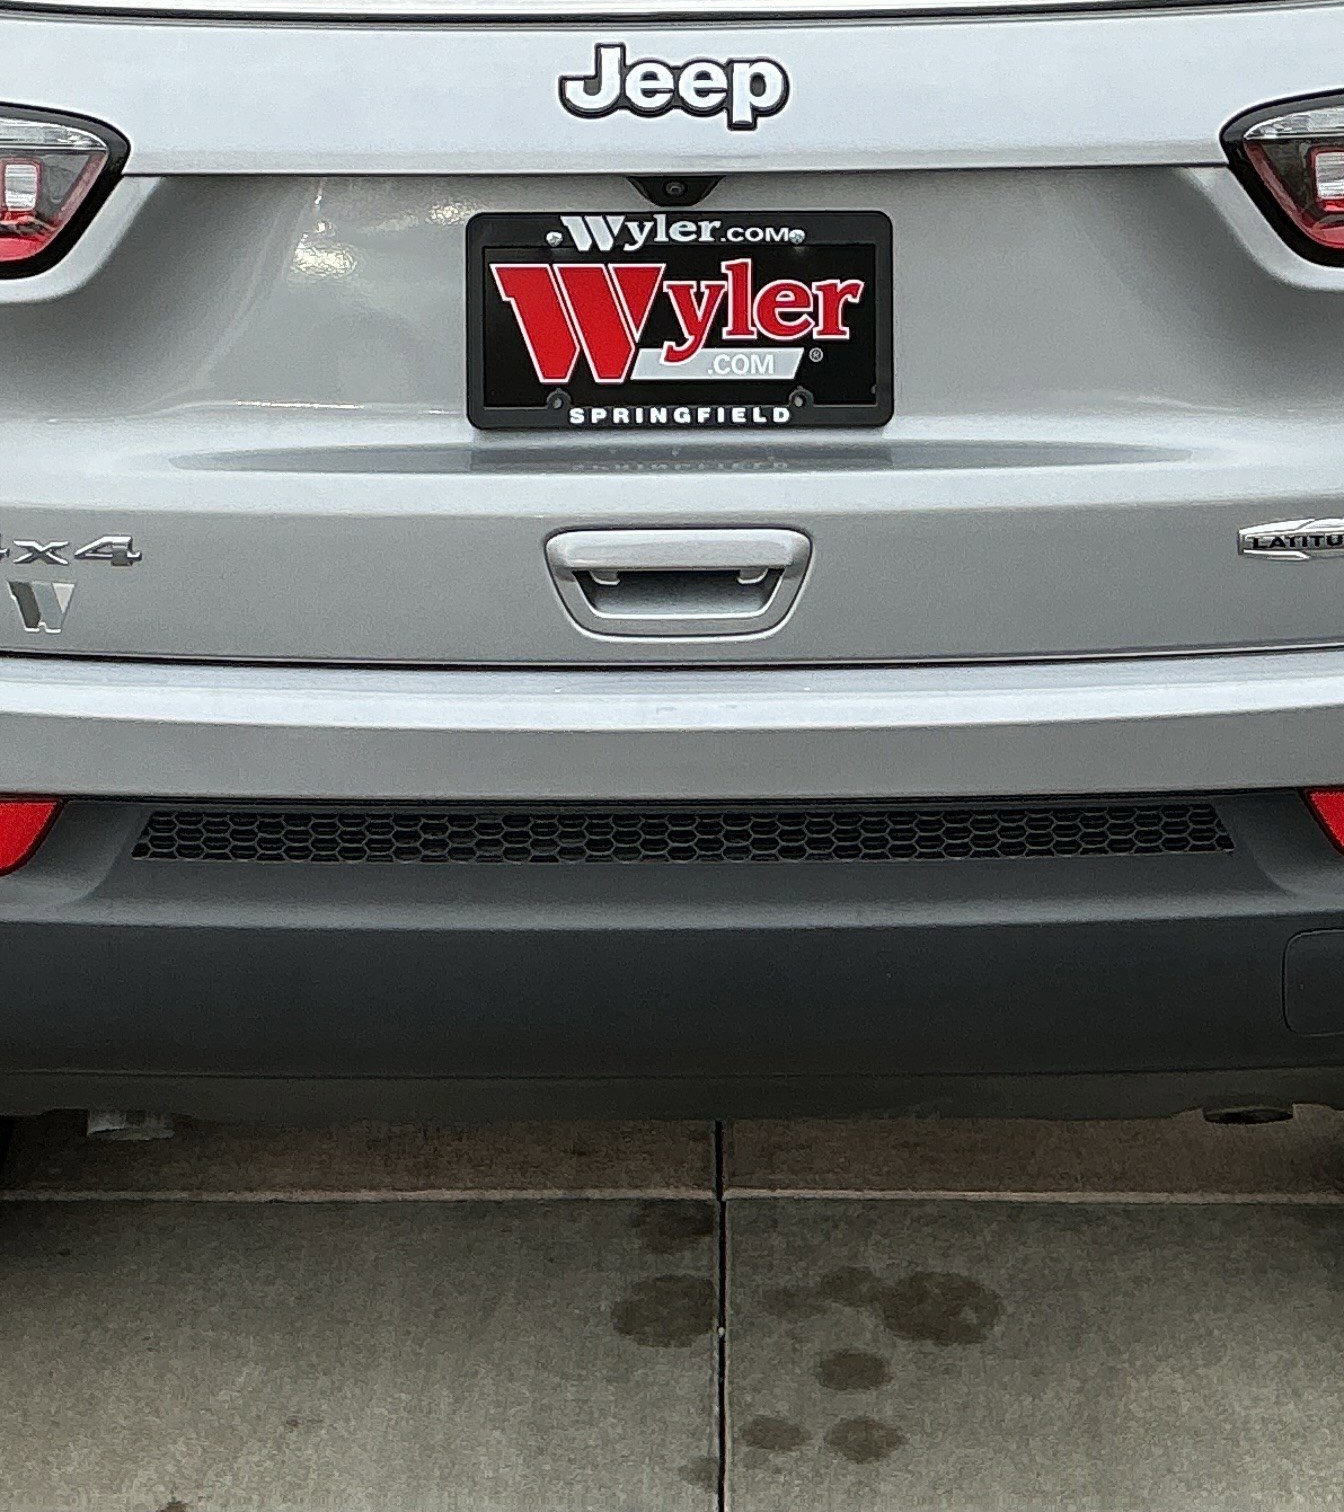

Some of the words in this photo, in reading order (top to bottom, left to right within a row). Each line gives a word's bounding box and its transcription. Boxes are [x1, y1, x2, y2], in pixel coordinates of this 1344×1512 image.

[558, 42, 790, 131] Jeep
[489, 258, 865, 385] Wyler
[569, 406, 791, 424] SPRINGFIELD
